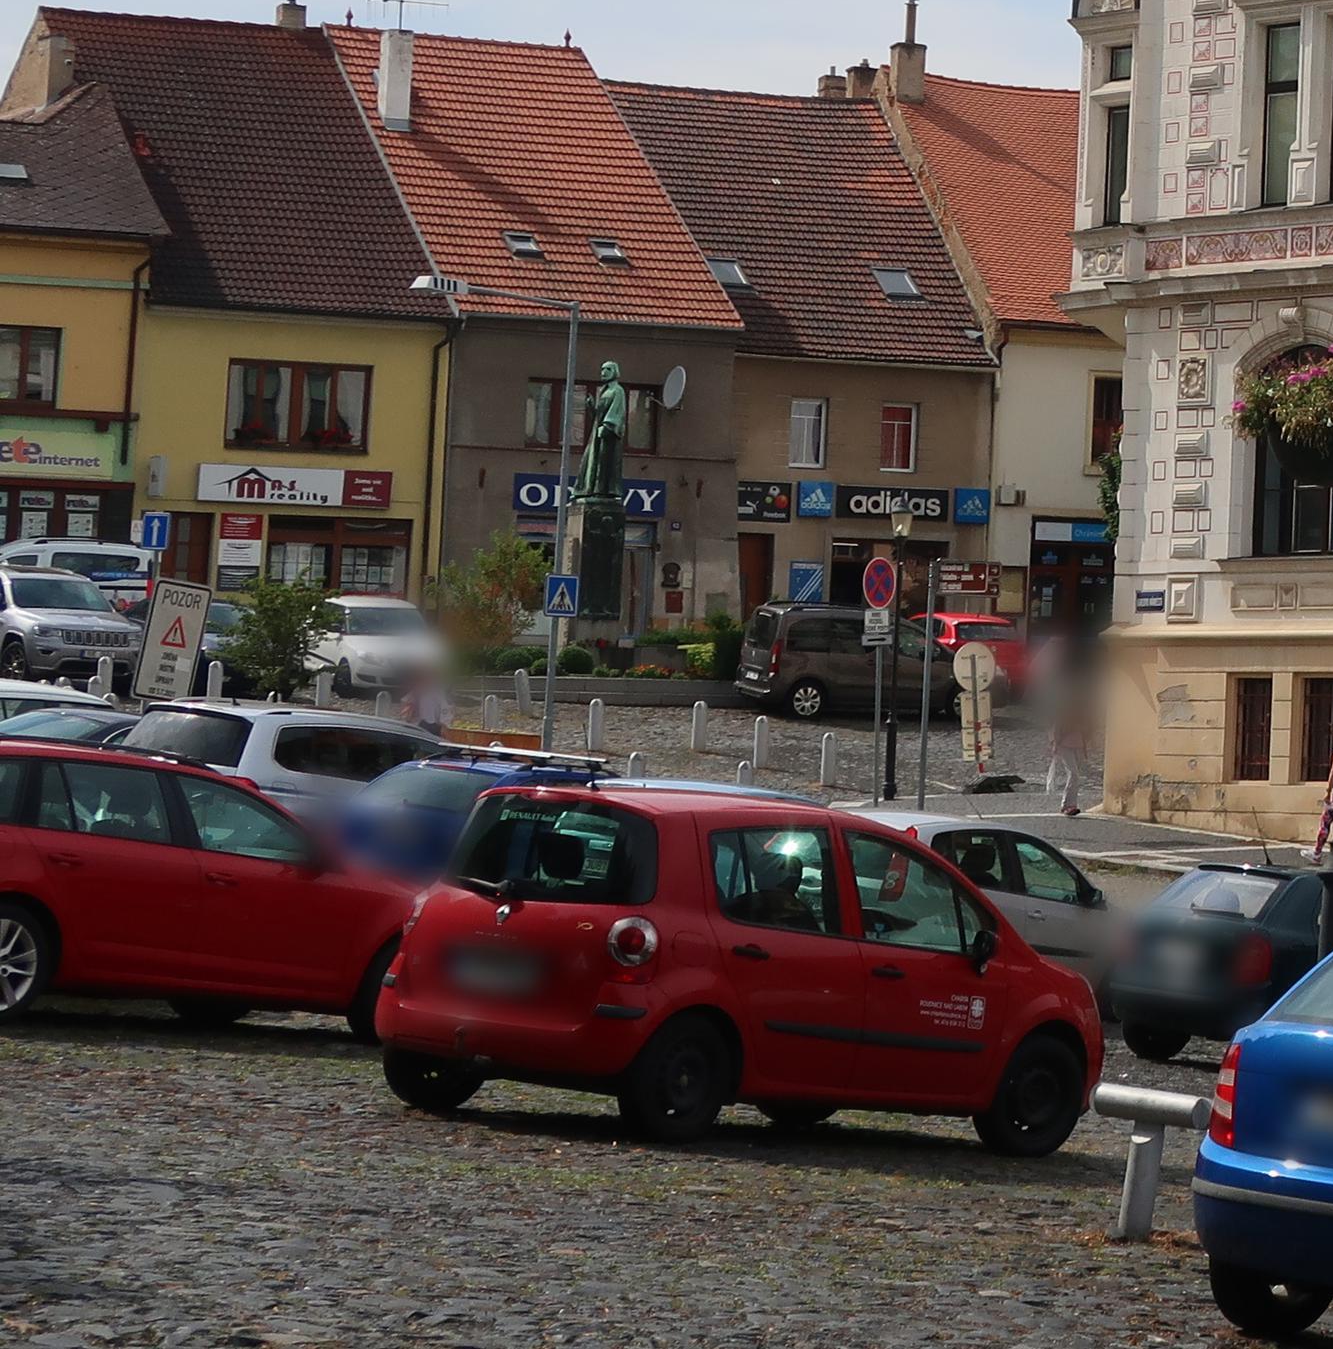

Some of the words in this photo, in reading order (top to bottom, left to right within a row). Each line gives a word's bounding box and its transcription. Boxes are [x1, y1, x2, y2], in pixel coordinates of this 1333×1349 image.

[39, 454, 100, 468] internet
[270, 492, 329, 505] reality
[800, 501, 832, 511] adidas
[161, 588, 202, 610] POZOR
